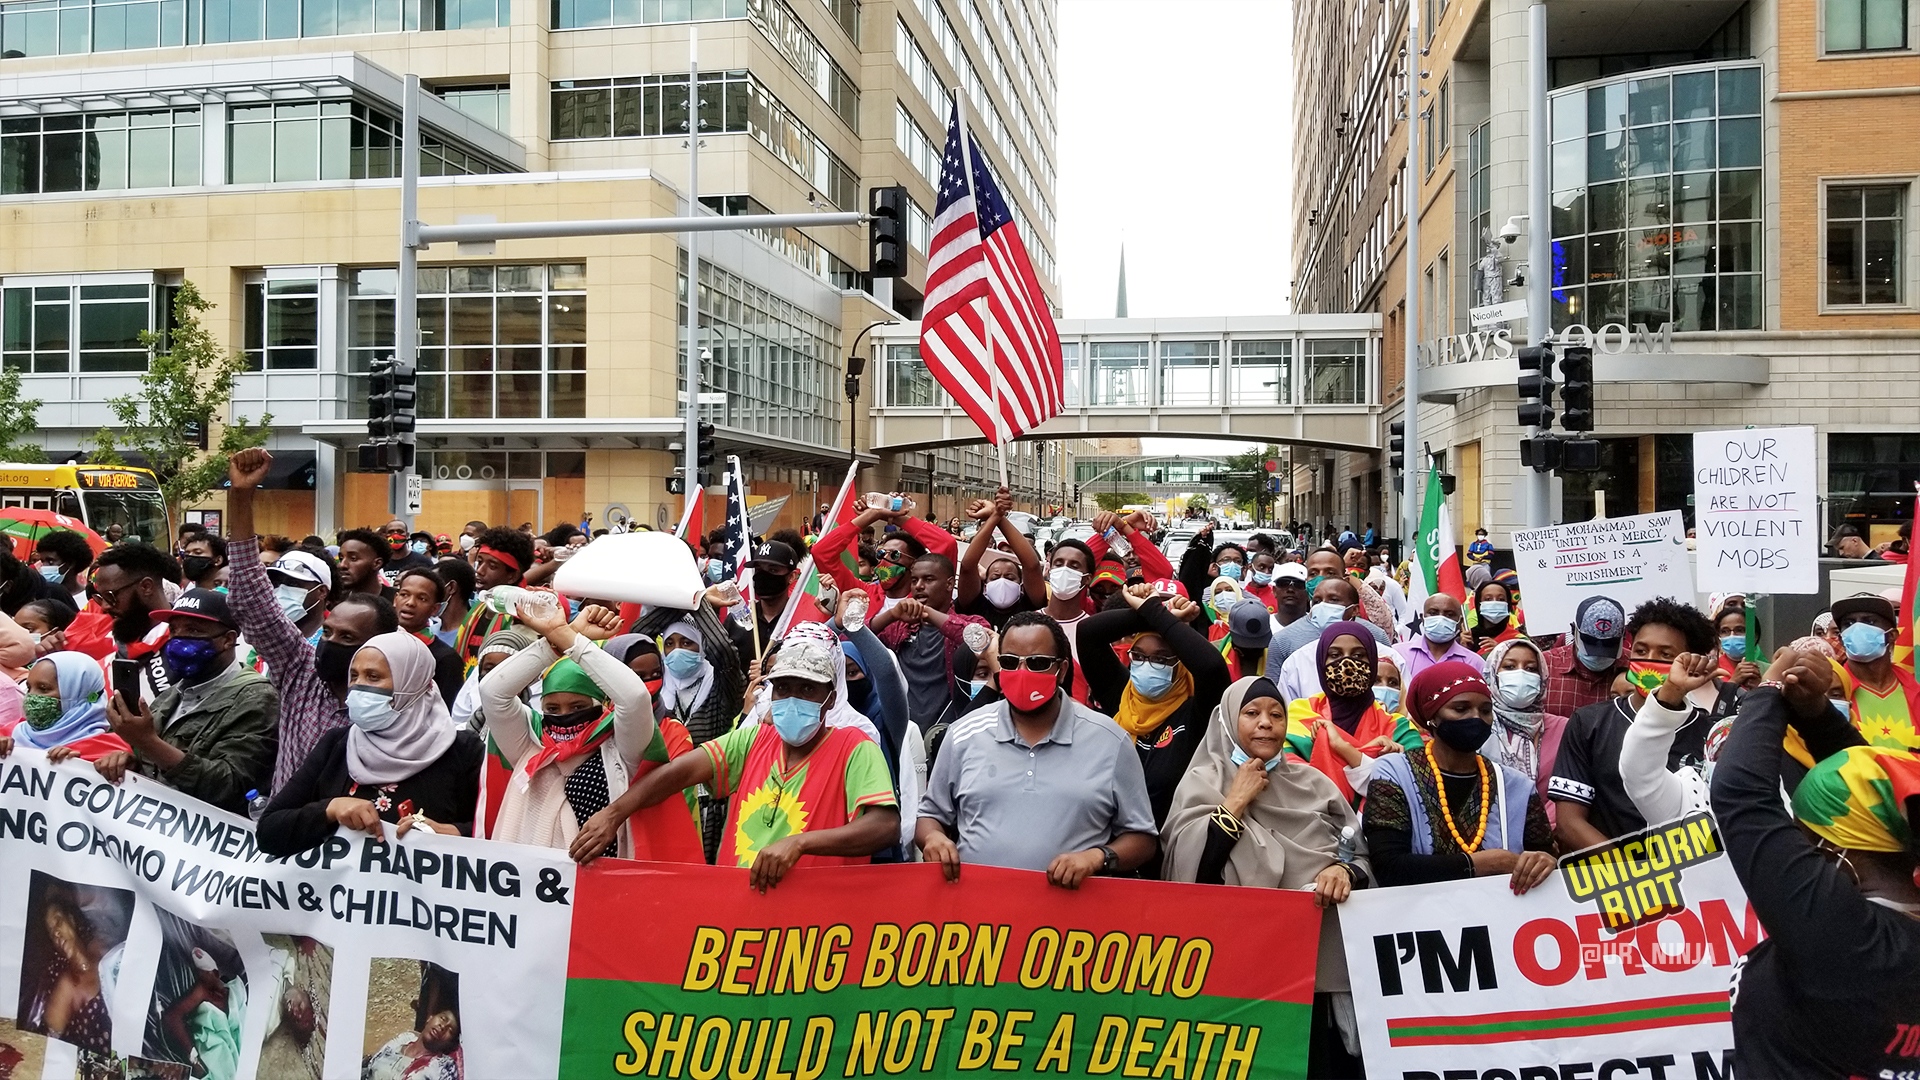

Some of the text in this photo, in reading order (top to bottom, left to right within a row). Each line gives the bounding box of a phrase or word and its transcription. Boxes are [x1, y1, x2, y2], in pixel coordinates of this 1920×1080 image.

[1473, 309, 1503, 321] Nicollet
[1424, 328, 1513, 369] NEWS
[1549, 322, 1674, 356] OOM
[1725, 438, 1778, 463] OUR
[98, 473, 112, 488] VIA
[113, 473, 137, 488] XERXES
[409, 479, 420, 488] ONE
[1697, 462, 1788, 486] CHILDREN
[408, 490, 420, 499] WAY
[1710, 491, 1797, 510] ARE NOT
[1514, 516, 1672, 543] PROPHET MOHAMMAD SAW
[1703, 519, 1803, 537] VIOLENT
[1518, 540, 1546, 552] SAID
[1593, 534, 1605, 545] IS
[1608, 534, 1617, 543] A
[1538, 548, 1641, 569] & DIVISION IS A
[1717, 548, 1790, 570] MOBS
[149, 650, 171, 692] ROM
[0, 763, 570, 906] AN GOVERNMEN OP RAPING &
[56, 821, 166, 882] OROMO
[171, 859, 290, 912] WOMEN
[297, 882, 324, 914] &
[329, 884, 518, 949] CHILDREN
[1372, 925, 1498, 997] I'M
[1512, 898, 1769, 987] OROM
[681, 921, 1214, 999] BEING BORN OROMO
[613, 1007, 1263, 1080] SHOULD NOT BE A DEATH
[1884, 1023, 1920, 1058] TO
